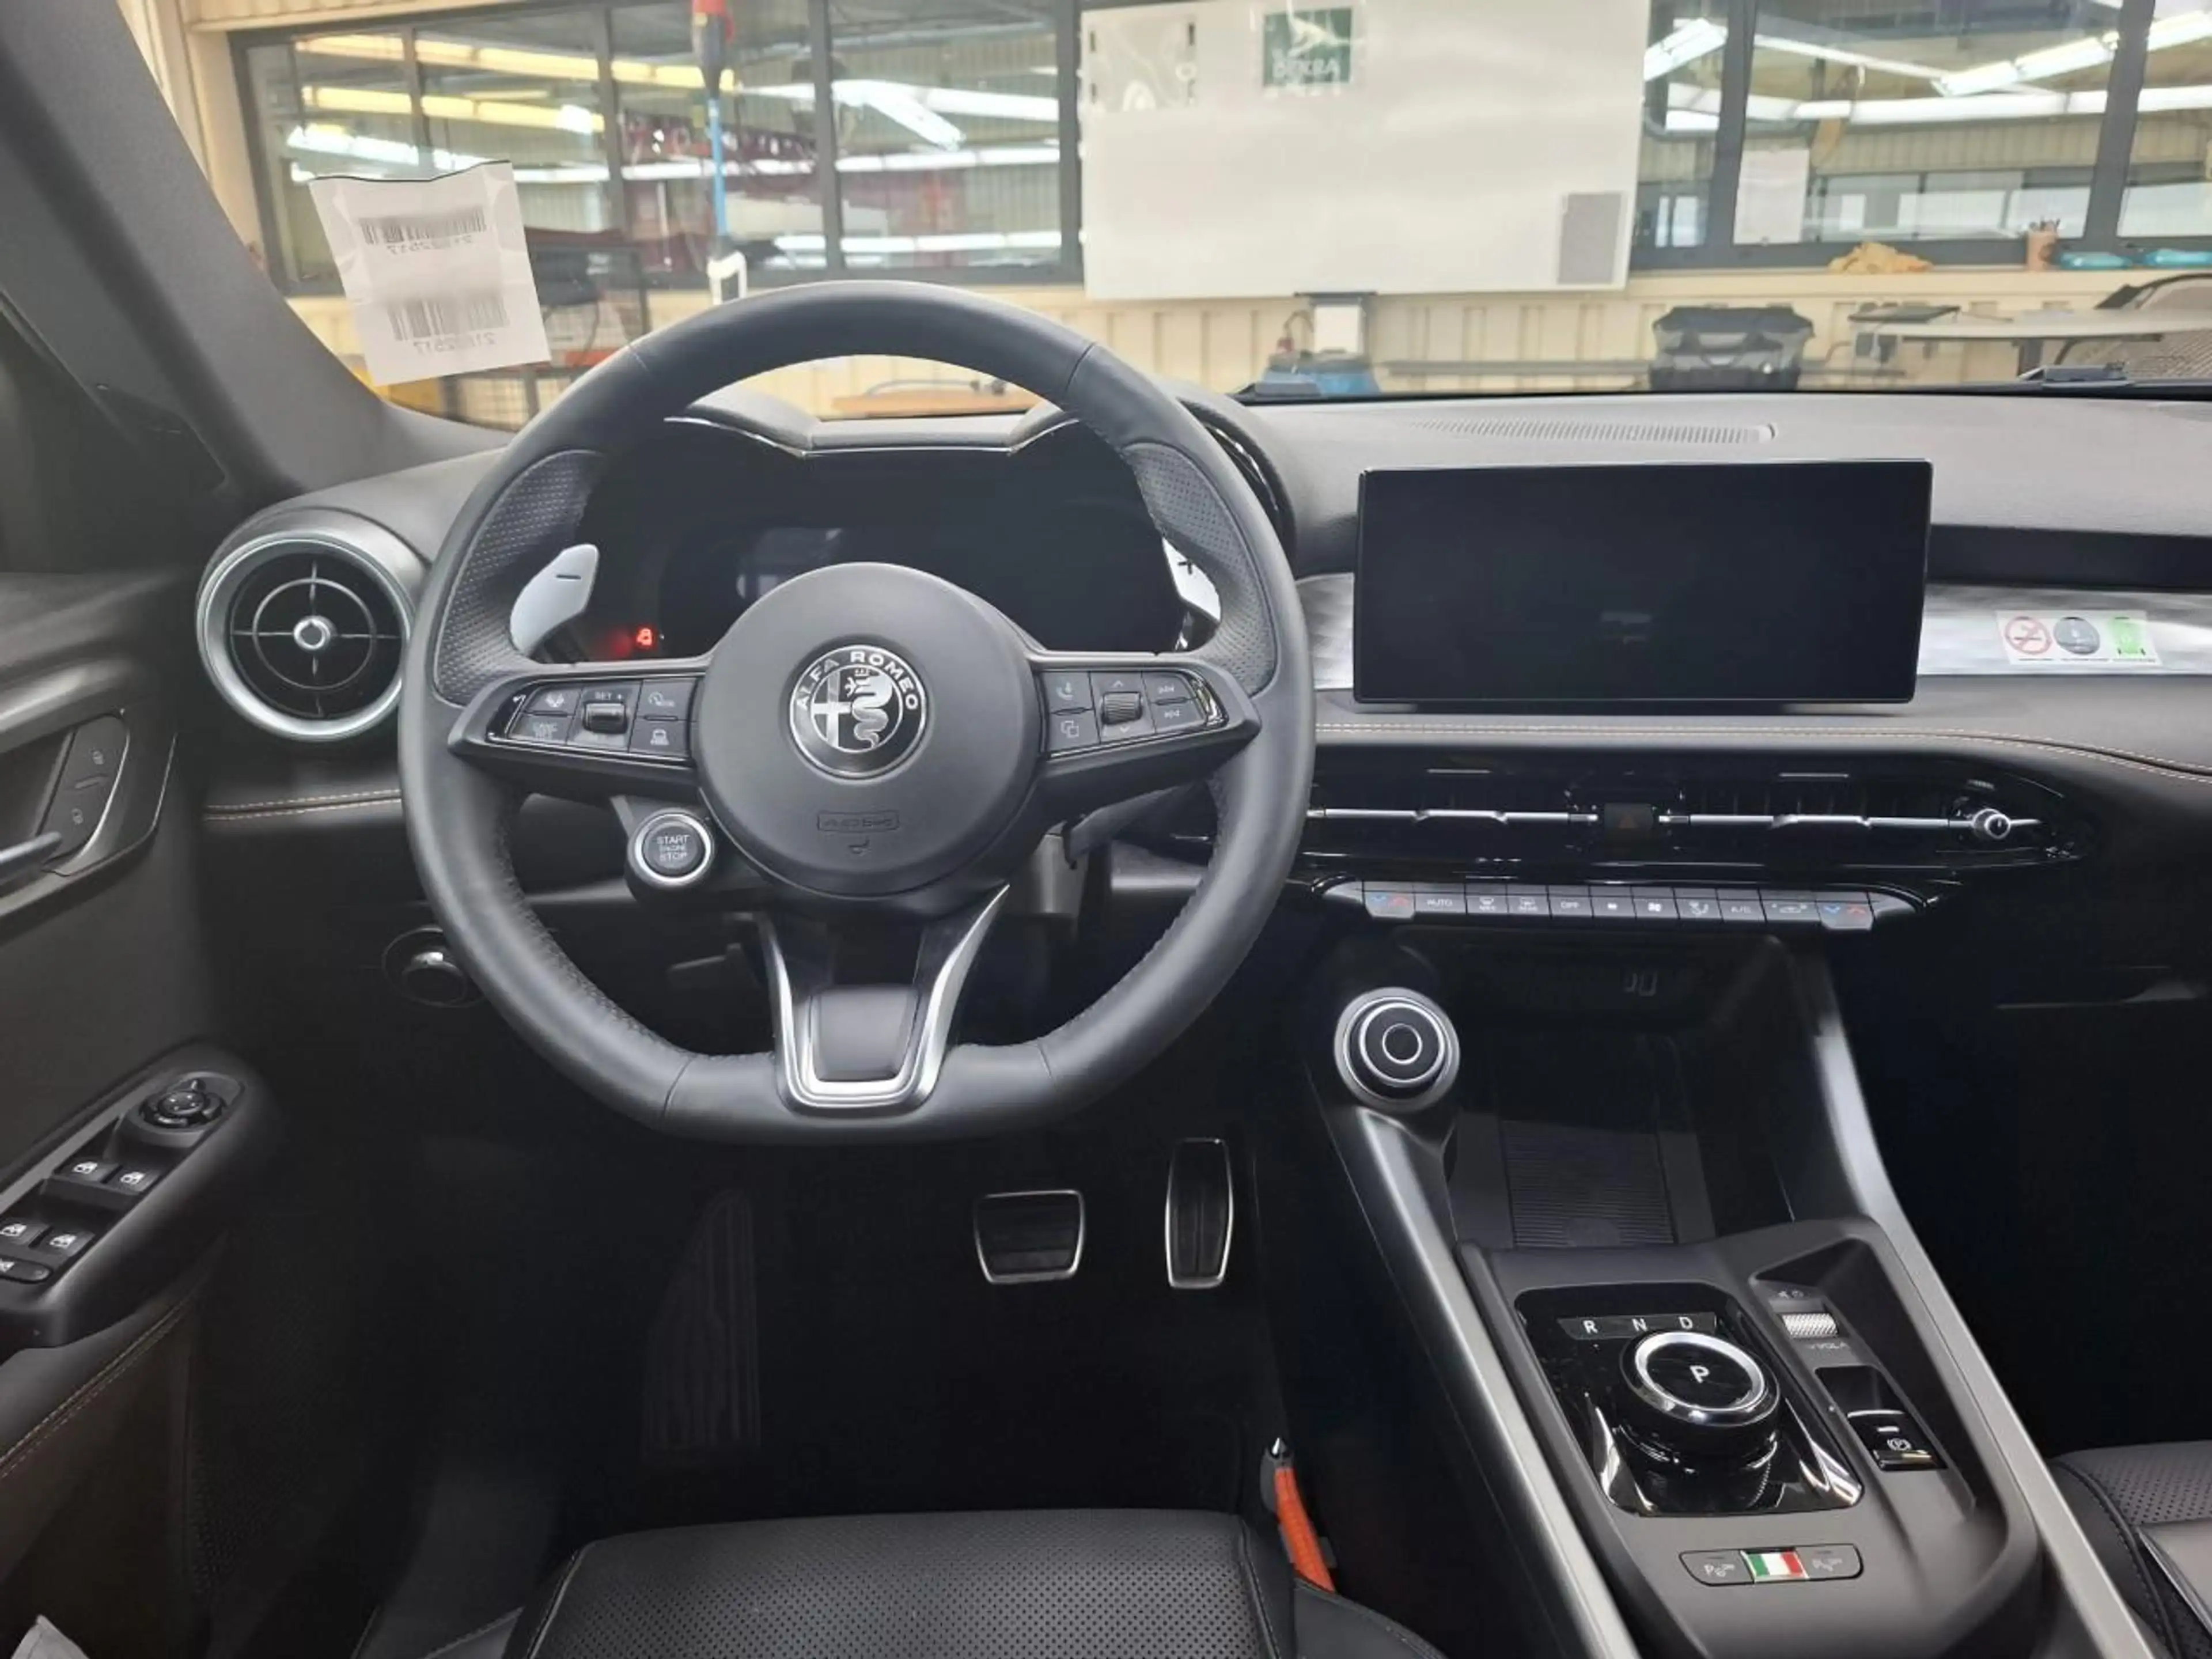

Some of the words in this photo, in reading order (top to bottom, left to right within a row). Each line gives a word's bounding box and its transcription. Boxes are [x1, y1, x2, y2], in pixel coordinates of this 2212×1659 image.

[796, 658, 839, 710] ALFA
[850, 651, 919, 710] ROMEO
[656, 834, 691, 844] START
[659, 852, 687, 862] STOP
[1427, 898, 1453, 907] AUTO
[1583, 1320, 1598, 1334] R
[1631, 1318, 1648, 1332] N
[1678, 1316, 1694, 1330] D
[1690, 1365, 1710, 1383] P
